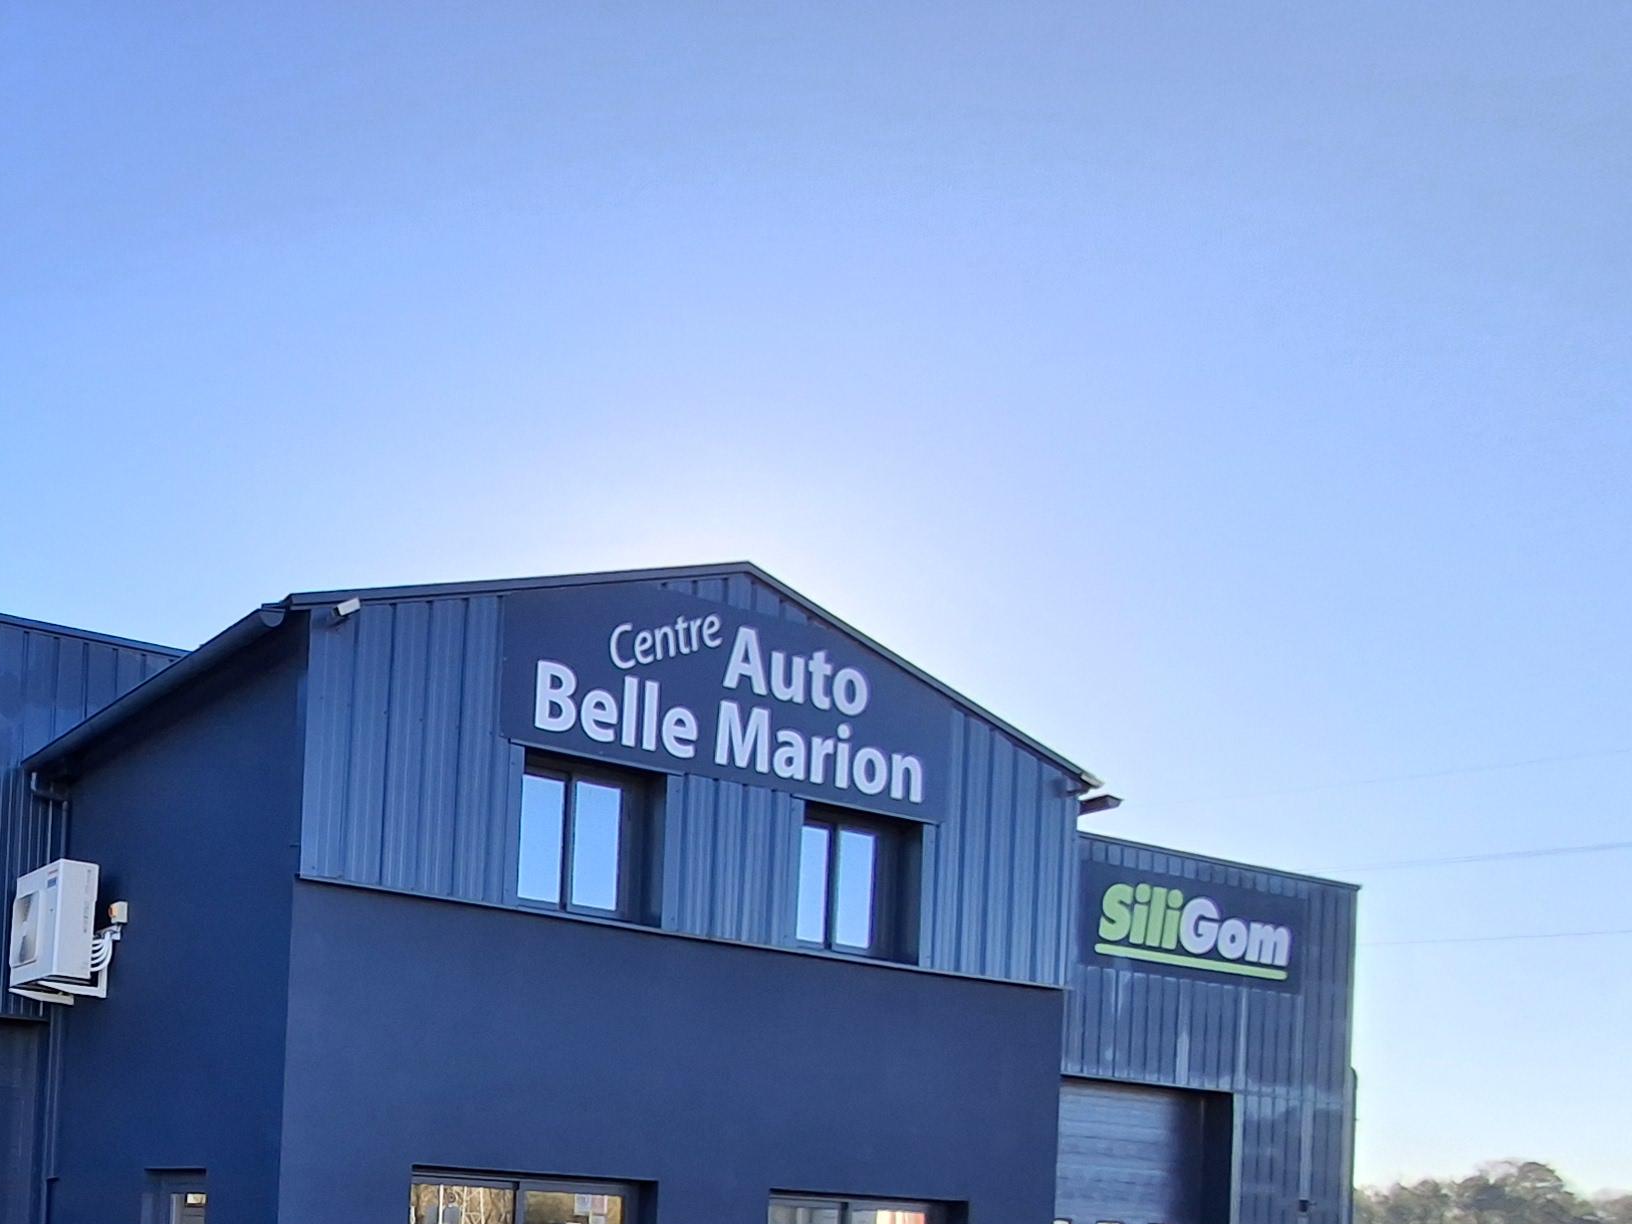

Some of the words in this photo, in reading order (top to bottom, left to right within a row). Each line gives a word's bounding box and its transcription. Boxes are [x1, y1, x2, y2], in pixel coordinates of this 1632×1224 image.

[609, 613, 723, 670] Centre
[722, 626, 869, 716] Auto
[533, 659, 698, 760] Belle
[713, 700, 924, 804] Marion
[1097, 883, 1292, 967] SiliGom
